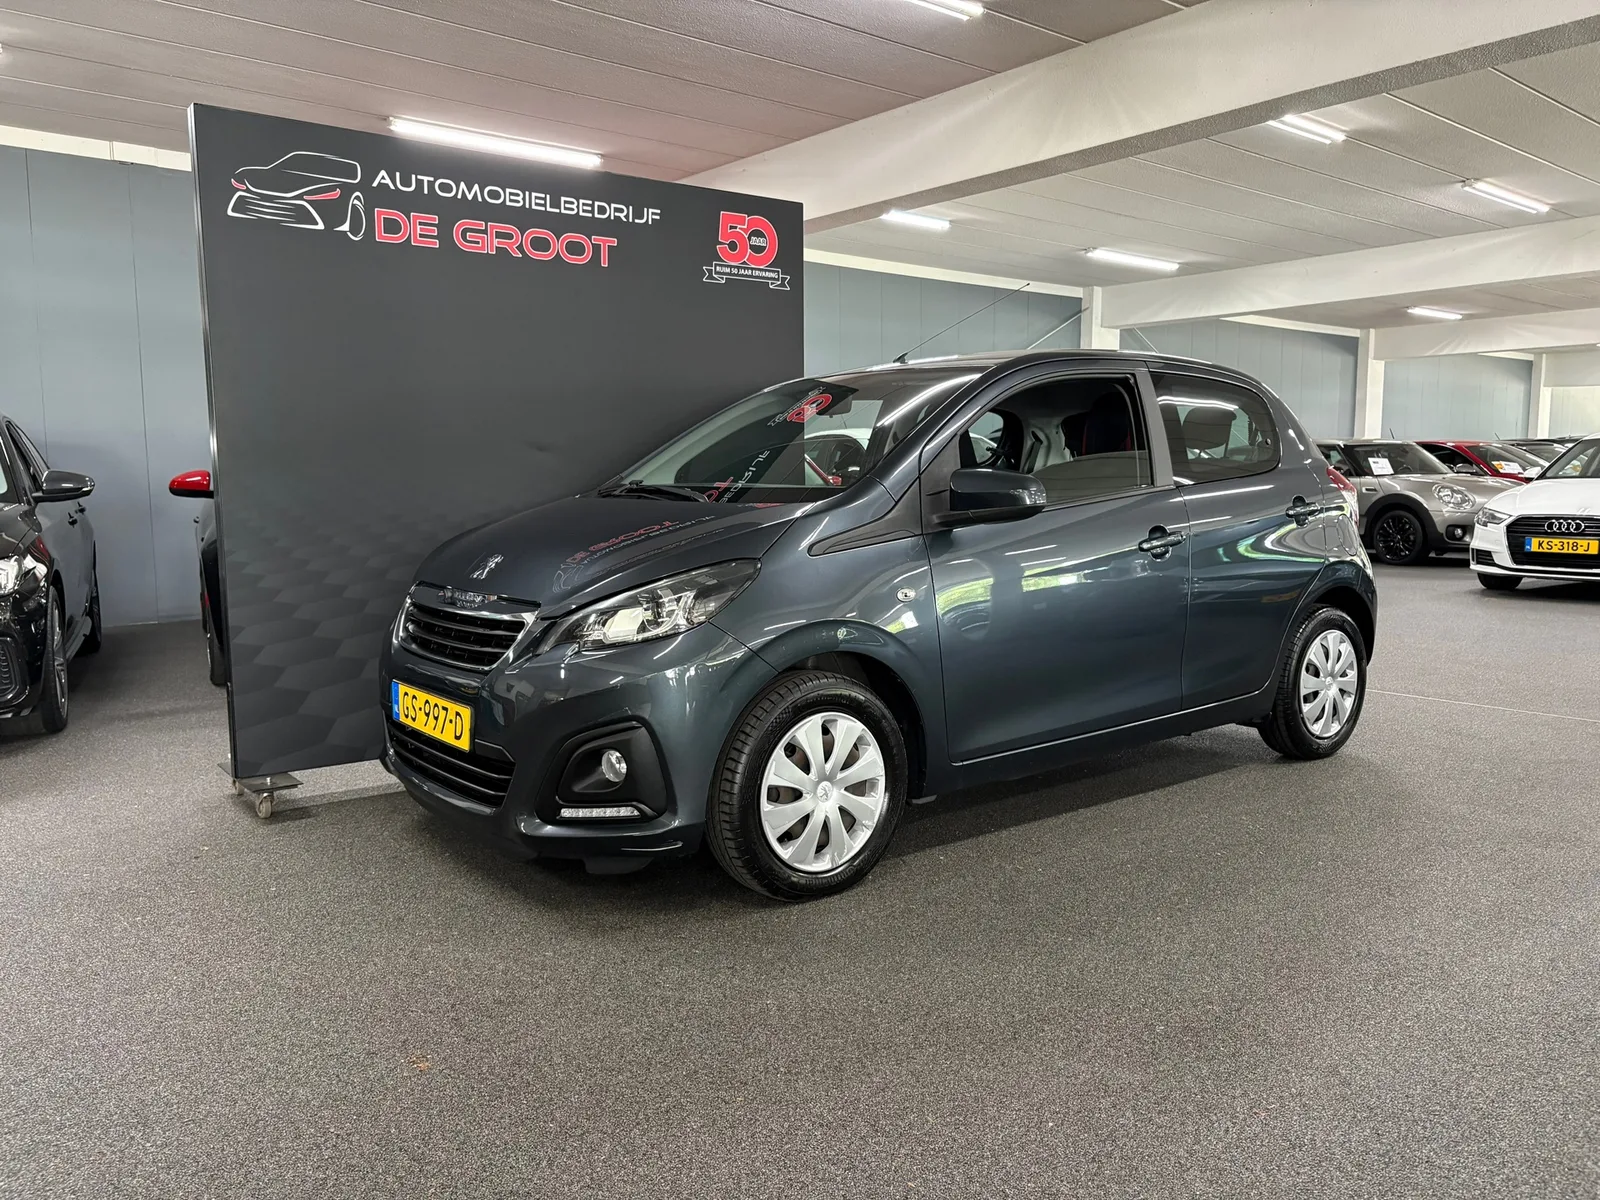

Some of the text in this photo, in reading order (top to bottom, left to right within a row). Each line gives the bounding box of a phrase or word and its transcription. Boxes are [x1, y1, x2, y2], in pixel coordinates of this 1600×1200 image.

[372, 169, 661, 225] AUTOMOBIELBEDRIJF
[375, 208, 618, 268] DE GROOT
[716, 211, 778, 268] 50
[750, 236, 767, 247] JAAR
[716, 265, 730, 273] RUIM
[753, 271, 778, 279] ERVARING
[1537, 540, 1590, 553] KS-318-J
[402, 691, 464, 741] GS-997-D
